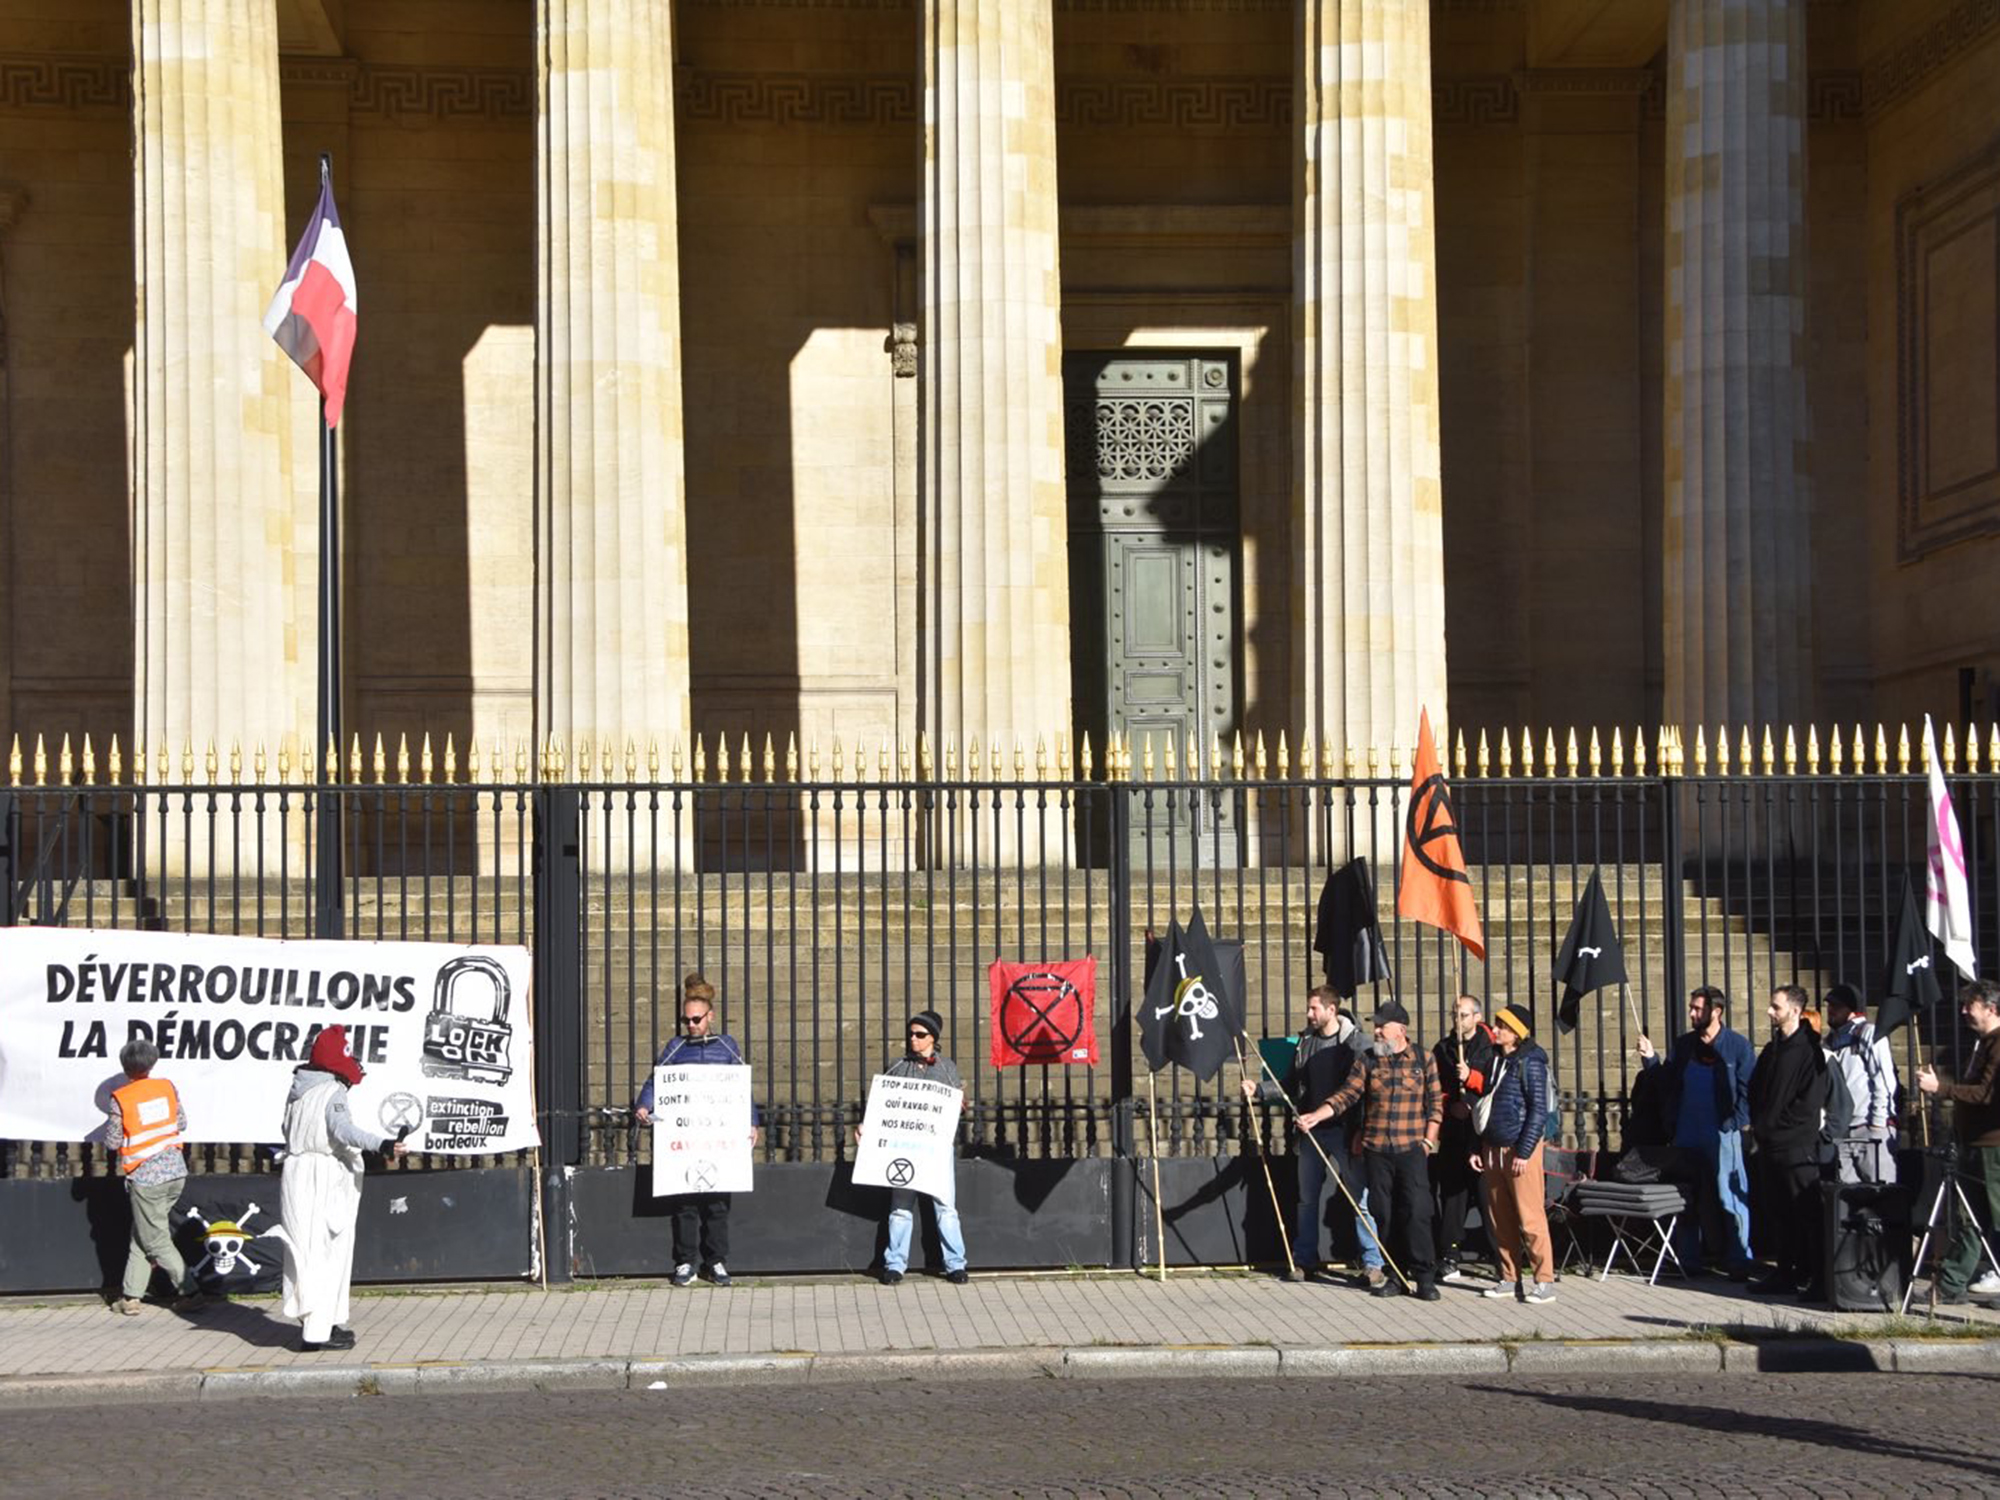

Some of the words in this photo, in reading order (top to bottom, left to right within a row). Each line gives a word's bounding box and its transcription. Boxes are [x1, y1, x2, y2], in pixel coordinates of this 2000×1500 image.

[47, 953, 416, 1013] DÉVERROUILLONS
[58, 1020, 108, 1058] LA
[127, 1010, 390, 1064] DÉMOCRAIE
[431, 1024, 504, 1054] LOCK
[441, 1045, 498, 1064] ON
[663, 1073, 677, 1083] LES
[881, 1079, 901, 1089] STOP
[903, 1081, 919, 1091] AUX
[921, 1083, 952, 1098] PROJETS
[430, 1100, 495, 1116] extinction
[658, 1094, 682, 1105] SONT
[885, 1096, 901, 1109] QUI
[902, 1101, 943, 1114] RAVAGNT
[448, 1118, 505, 1136] rebellion
[881, 1119, 898, 1129] NOS
[425, 1132, 488, 1150] bordeaux
[878, 1138, 888, 1148] ET
